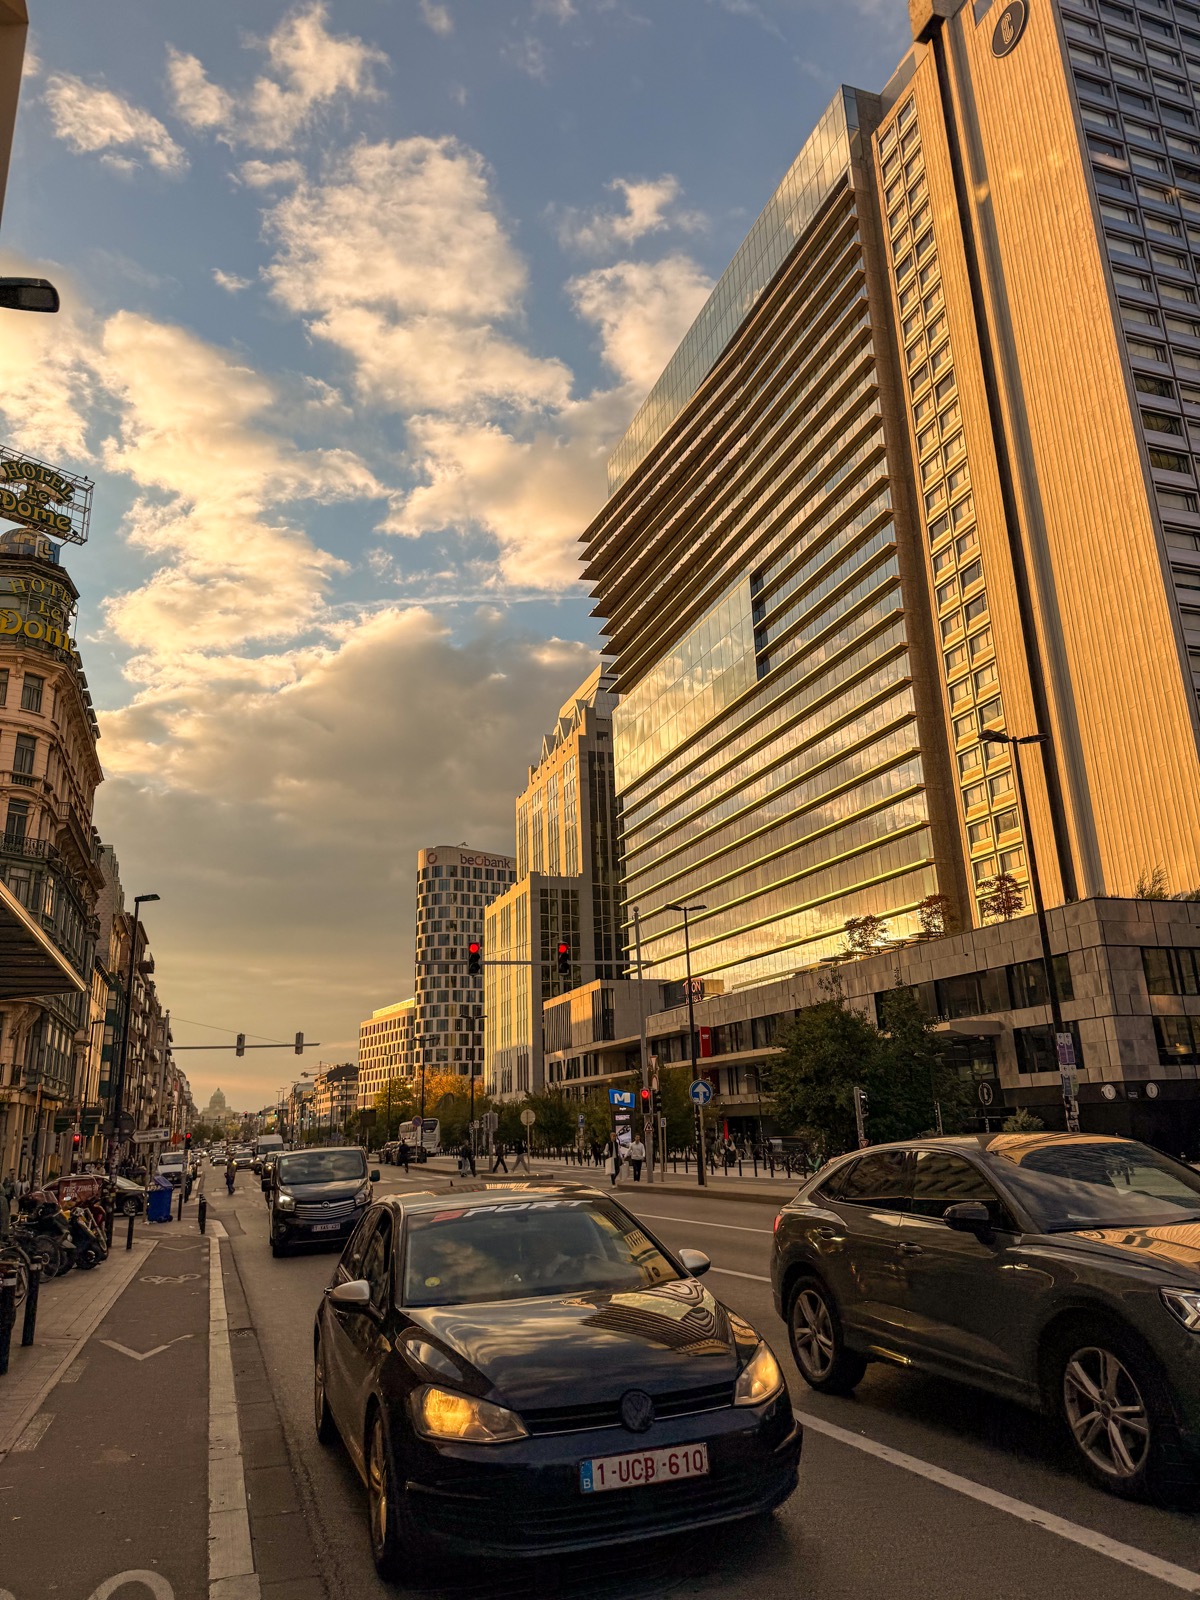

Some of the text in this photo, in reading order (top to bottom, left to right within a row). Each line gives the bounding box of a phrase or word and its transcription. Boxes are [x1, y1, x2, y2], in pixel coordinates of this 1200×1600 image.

[3, 461, 74, 502] HOTEL
[26, 485, 49, 503] Le
[0, 488, 71, 532] Dome
[8, 578, 72, 606] HOTE
[0, 609, 78, 658] Dome
[430, 1200, 594, 1223] SPORT
[583, 1449, 704, 1489] B 1-UCB-610
